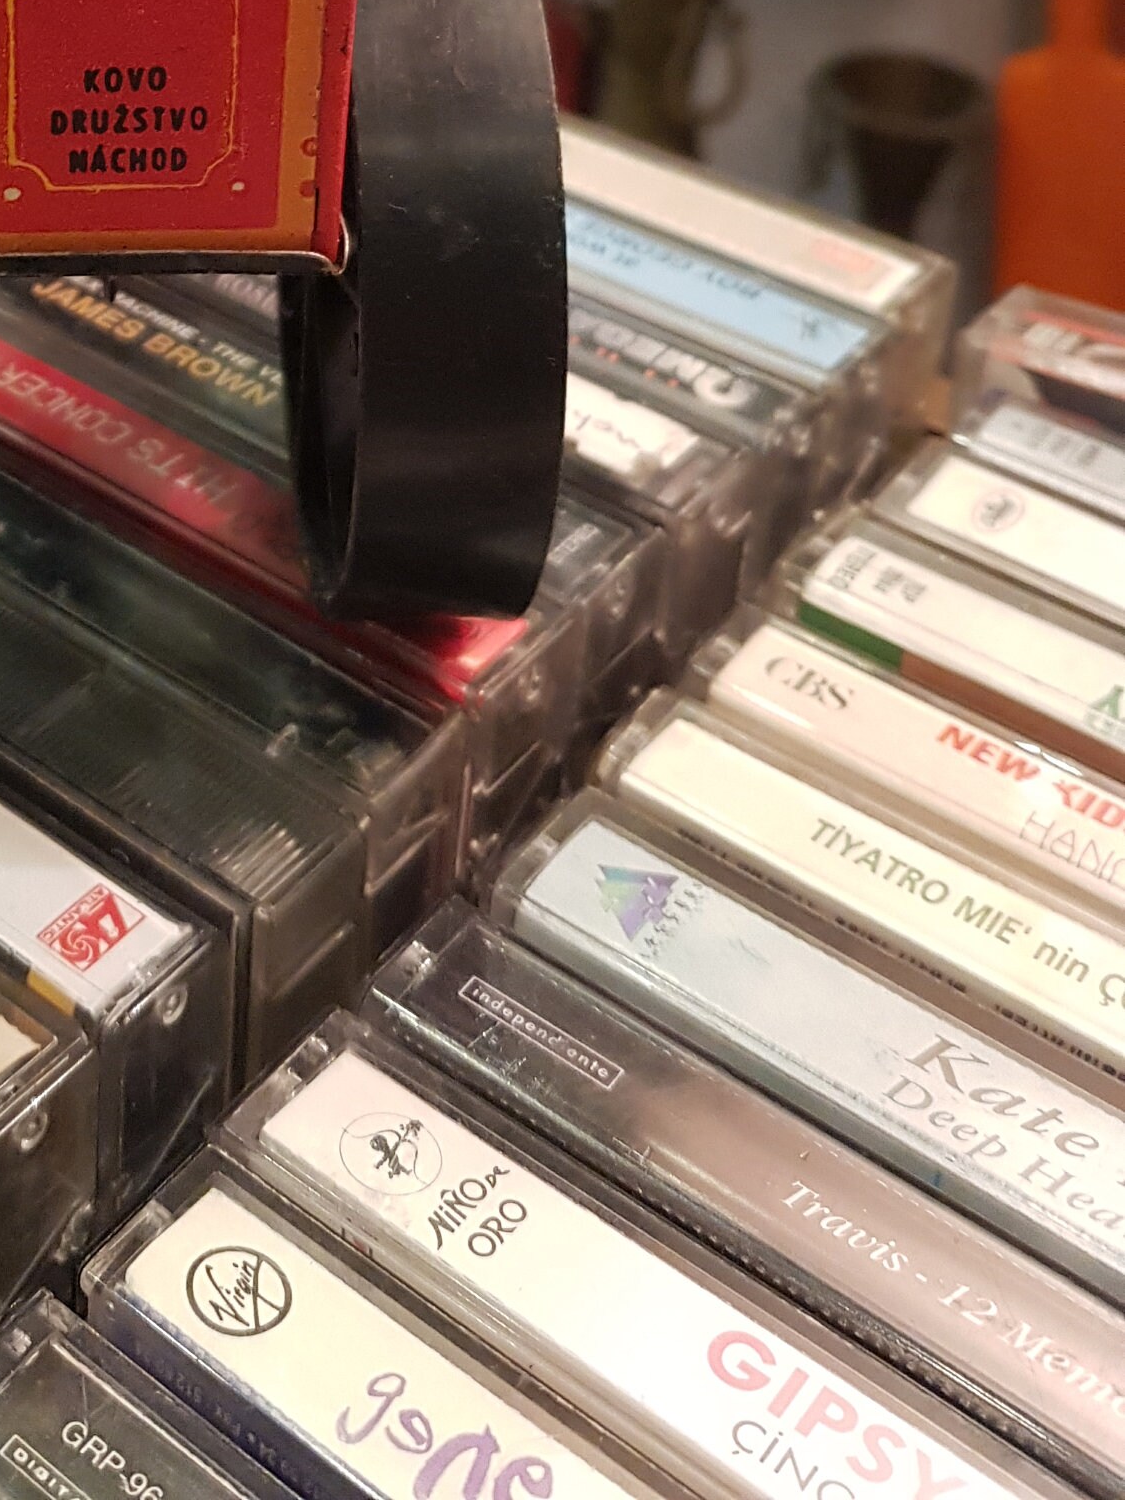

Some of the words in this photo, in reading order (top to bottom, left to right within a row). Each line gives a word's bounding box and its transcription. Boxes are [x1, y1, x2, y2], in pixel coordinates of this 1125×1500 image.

[83, 66, 167, 93] KOVO
[50, 104, 208, 135] DRUŽSTVO
[69, 145, 187, 173] NÁCHOD
[31, 279, 146, 341] JAMES
[142, 331, 282, 408] BROWN
[764, 655, 855, 710] CBS
[934, 722, 1042, 783] NEW
[1051, 778, 1125, 831] KID
[42, 885, 107, 940] ATLANTIC
[1032, 941, 1091, 983] nin
[905, 1033, 1100, 1159] Kate
[882, 1074, 1008, 1159] Deep
[1017, 1155, 1125, 1232] Hea
[467, 1198, 528, 1257] ORO
[779, 1180, 909, 1272] Travis
[939, 1277, 998, 1327] 12
[200, 1255, 287, 1330] Virgin
[707, 1330, 969, 1500] GIPSY
[12, 1447, 81, 1500] DIGIT
